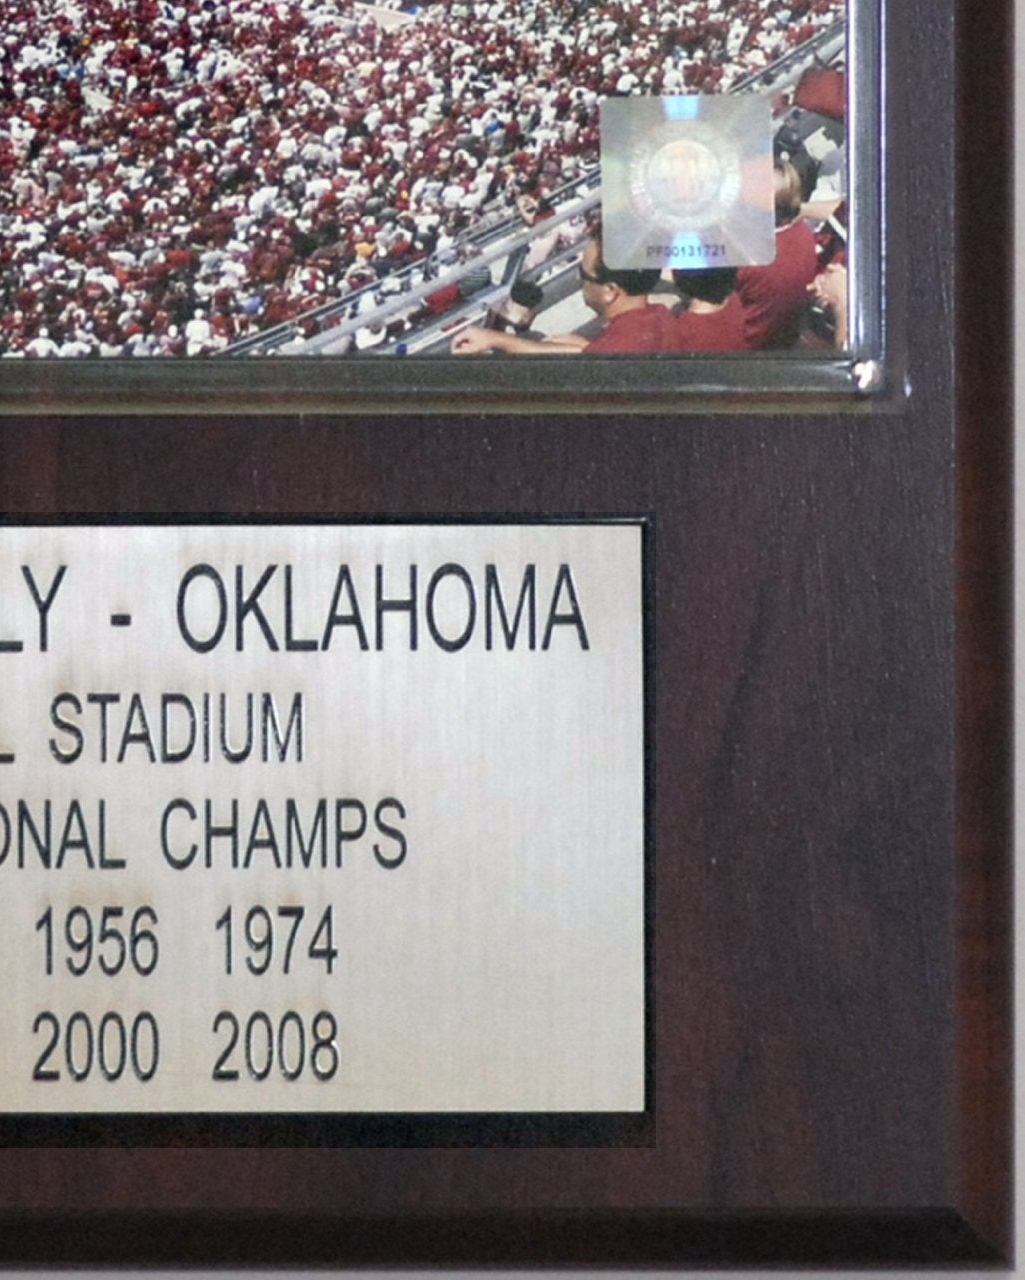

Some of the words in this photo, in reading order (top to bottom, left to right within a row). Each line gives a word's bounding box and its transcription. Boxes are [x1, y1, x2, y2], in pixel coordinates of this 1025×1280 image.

[110, 613, 131, 627] -
[176, 563, 590, 654] OKLAHOMA
[48, 691, 303, 765] STADIUM
[159, 797, 408, 871] CHAMPS
[35, 905, 159, 978] 1956
[216, 905, 339, 977] 1974
[31, 1011, 160, 1084] 2000
[212, 1010, 339, 1083] 2008
